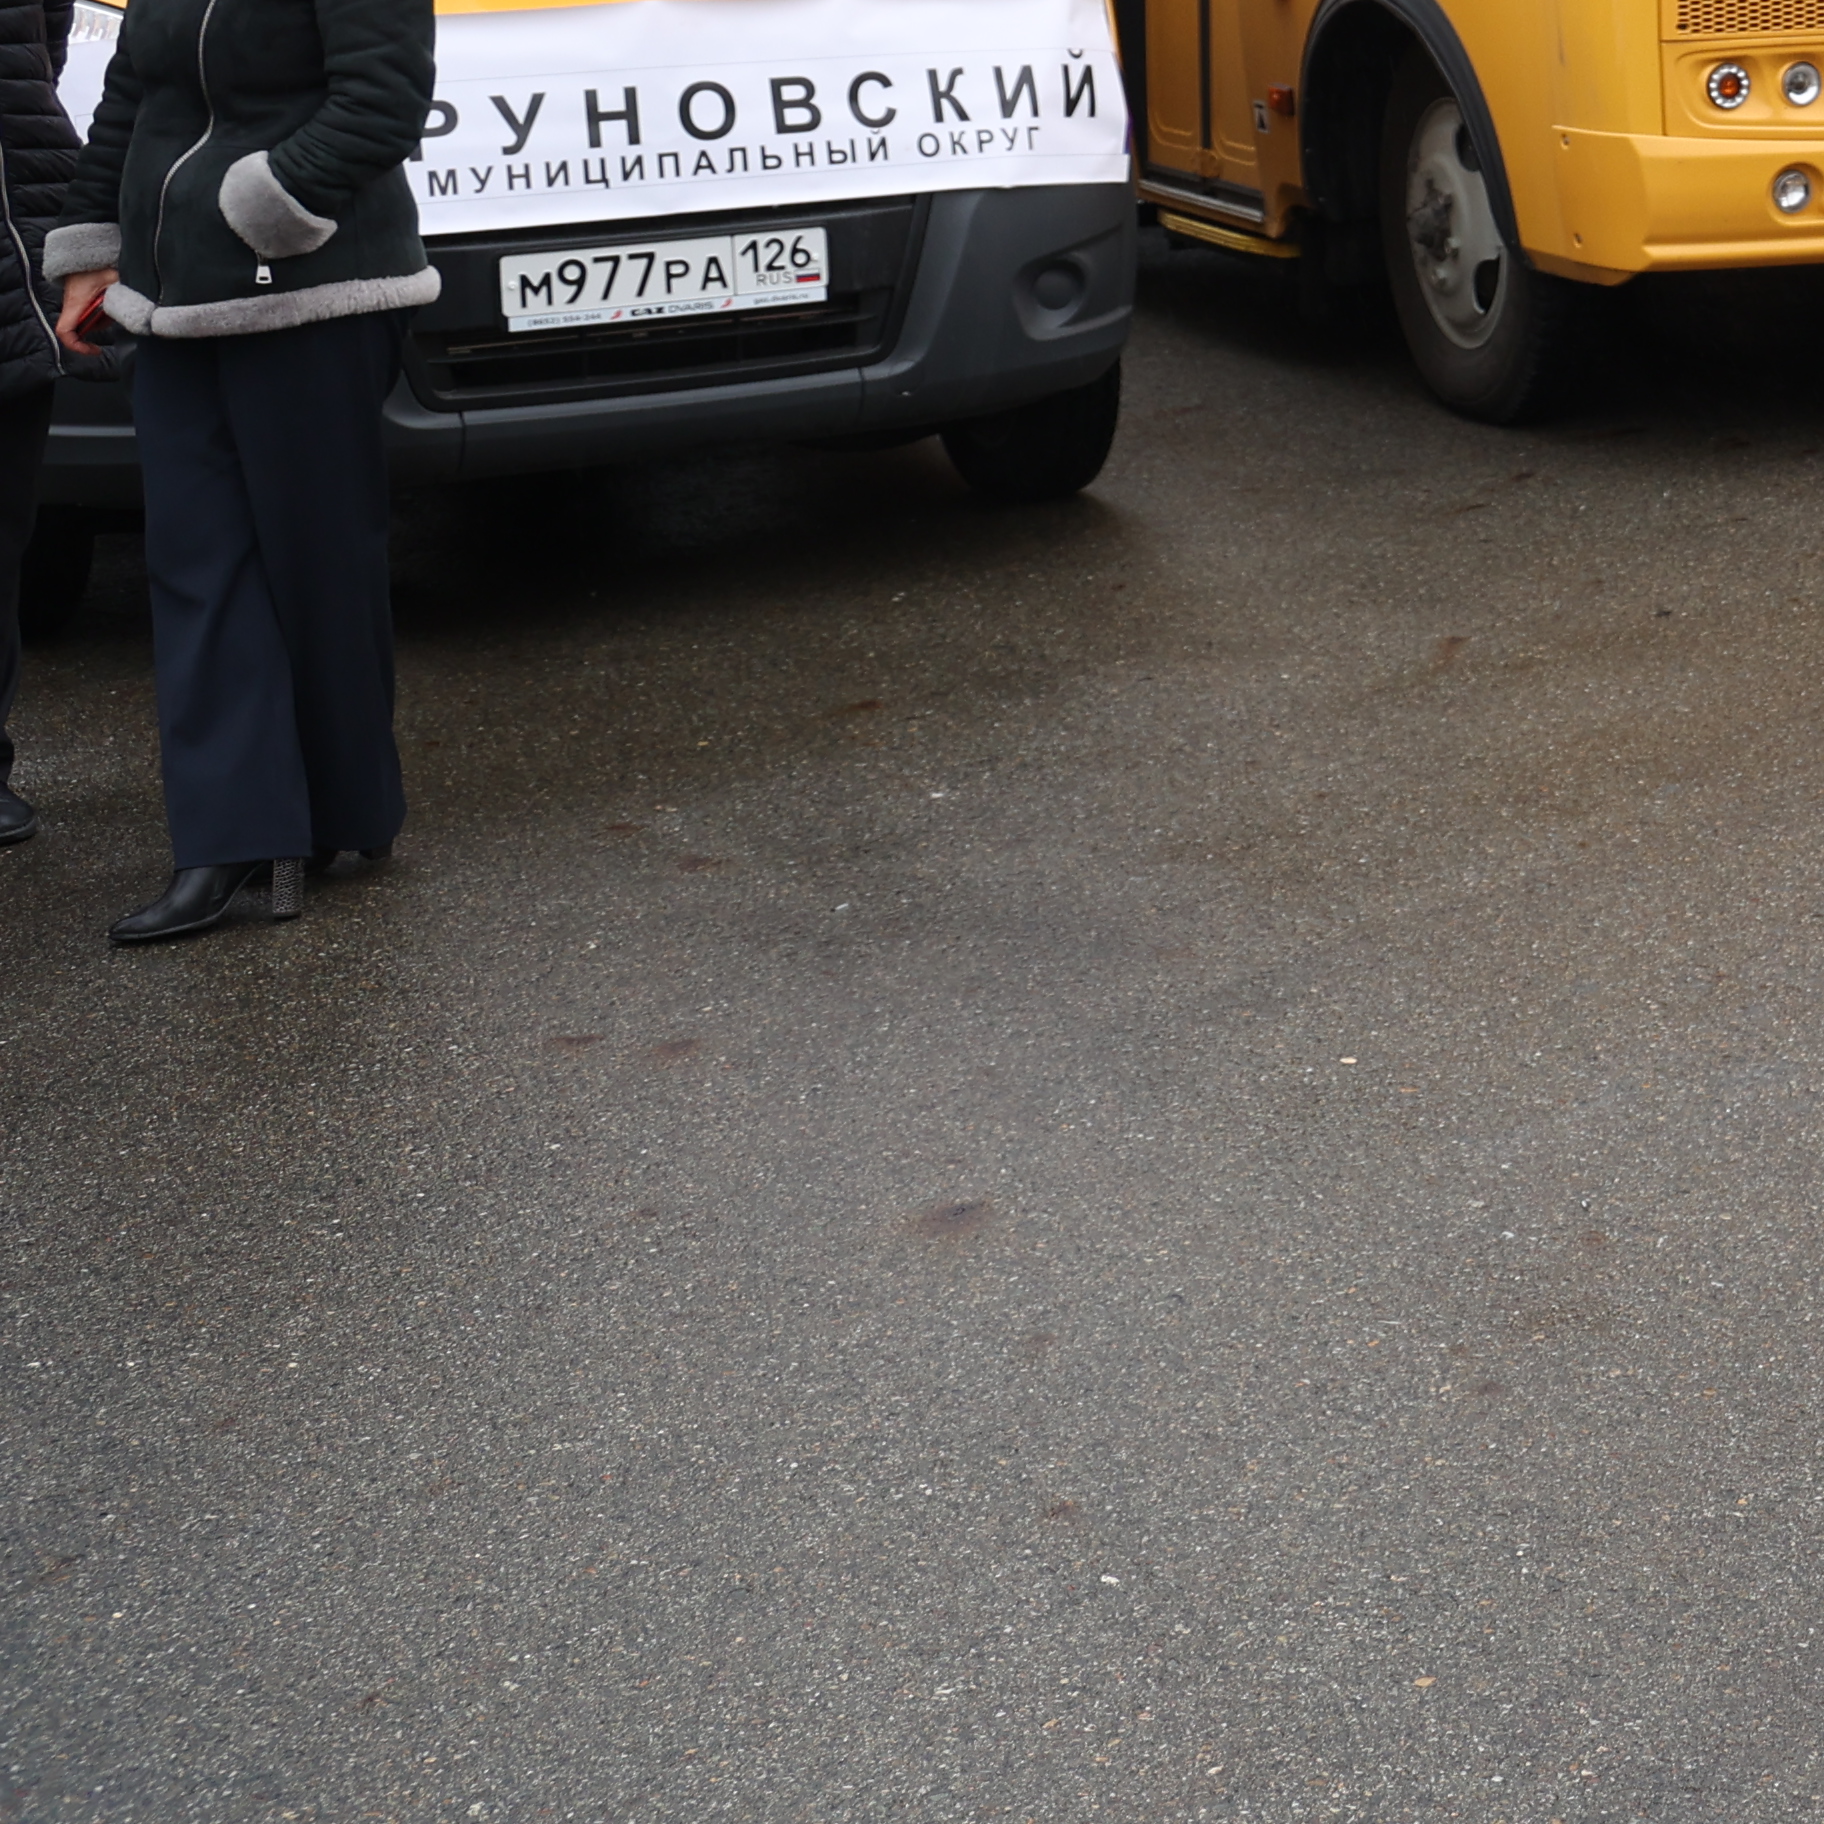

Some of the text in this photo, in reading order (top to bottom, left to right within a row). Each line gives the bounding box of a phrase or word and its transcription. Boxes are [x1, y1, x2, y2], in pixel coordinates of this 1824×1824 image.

[409, 48, 1097, 162] РУНОВСКИЙ
[427, 126, 1041, 197] МУНИЦИПАЛЬНЫЙ ОКРУГ
[518, 234, 813, 309] М977РА 126
[756, 271, 793, 286] RUS
